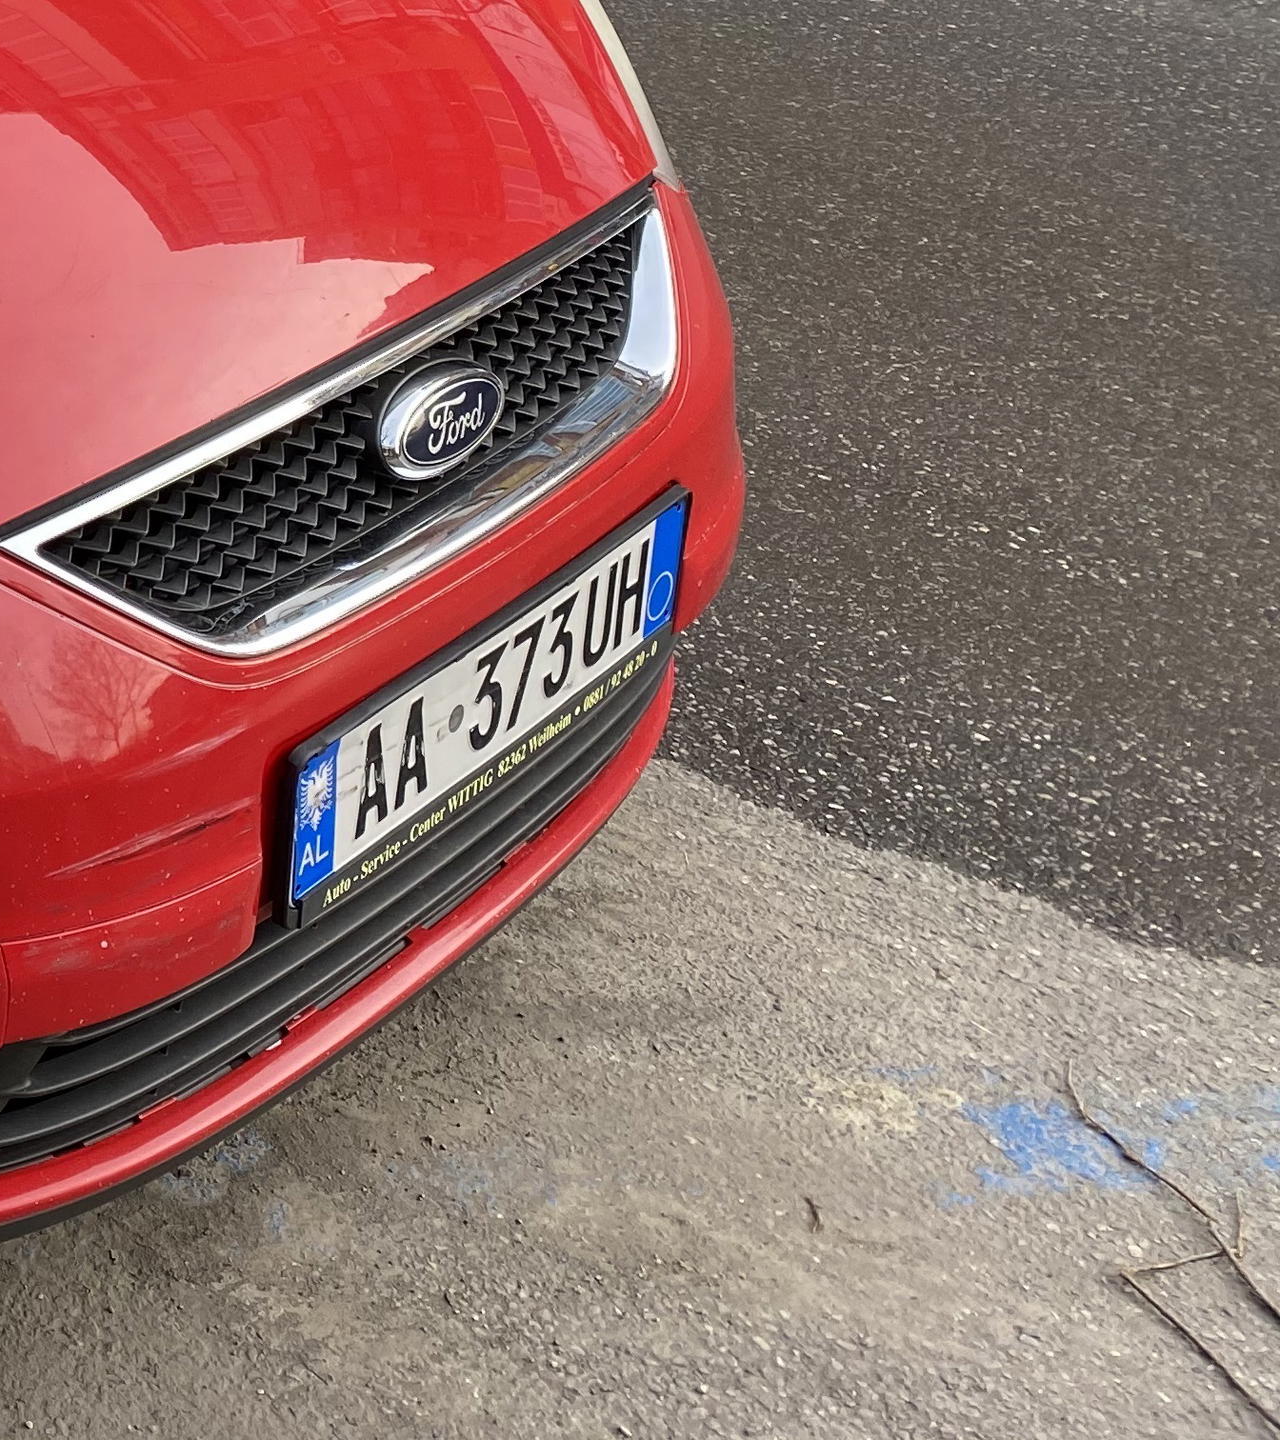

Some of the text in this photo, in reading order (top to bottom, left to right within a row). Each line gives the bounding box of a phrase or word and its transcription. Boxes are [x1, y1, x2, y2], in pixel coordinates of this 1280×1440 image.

[427, 391, 486, 455] Ford
[322, 878, 352, 908] Auto
[360, 842, 400, 880] Service
[409, 806, 446, 842] Center
[447, 773, 494, 812] WITTIG
[497, 743, 527, 778] 82362
[528, 712, 572, 753] Weilheim
[583, 684, 605, 712] 0881
[354, 695, 428, 840] AA
[299, 835, 329, 876] AL
